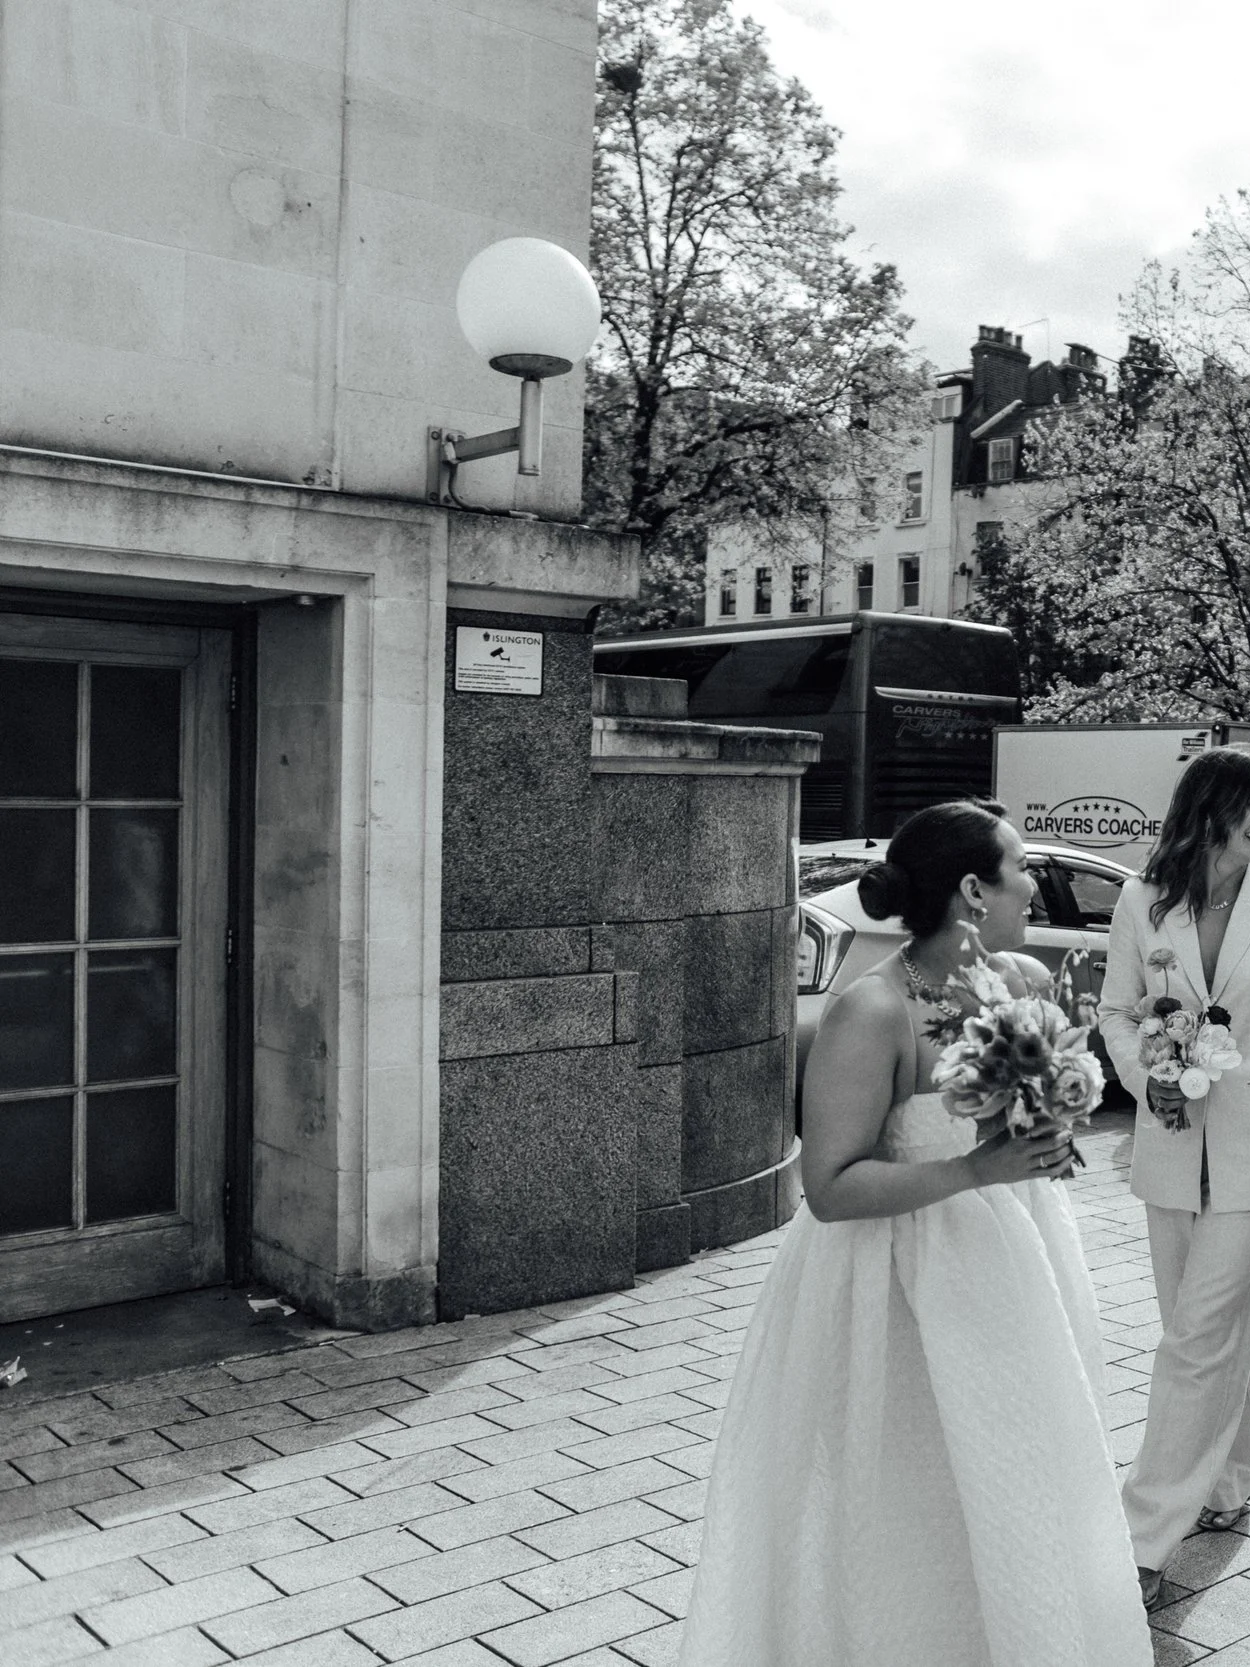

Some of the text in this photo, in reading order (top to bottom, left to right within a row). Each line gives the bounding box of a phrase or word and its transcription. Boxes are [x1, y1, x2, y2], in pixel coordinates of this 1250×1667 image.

[492, 634, 541, 646] ISLINGTON
[892, 705, 961, 717] CARVERS
[1026, 803, 1049, 811] www.
[1024, 816, 1093, 834] CARVERS
